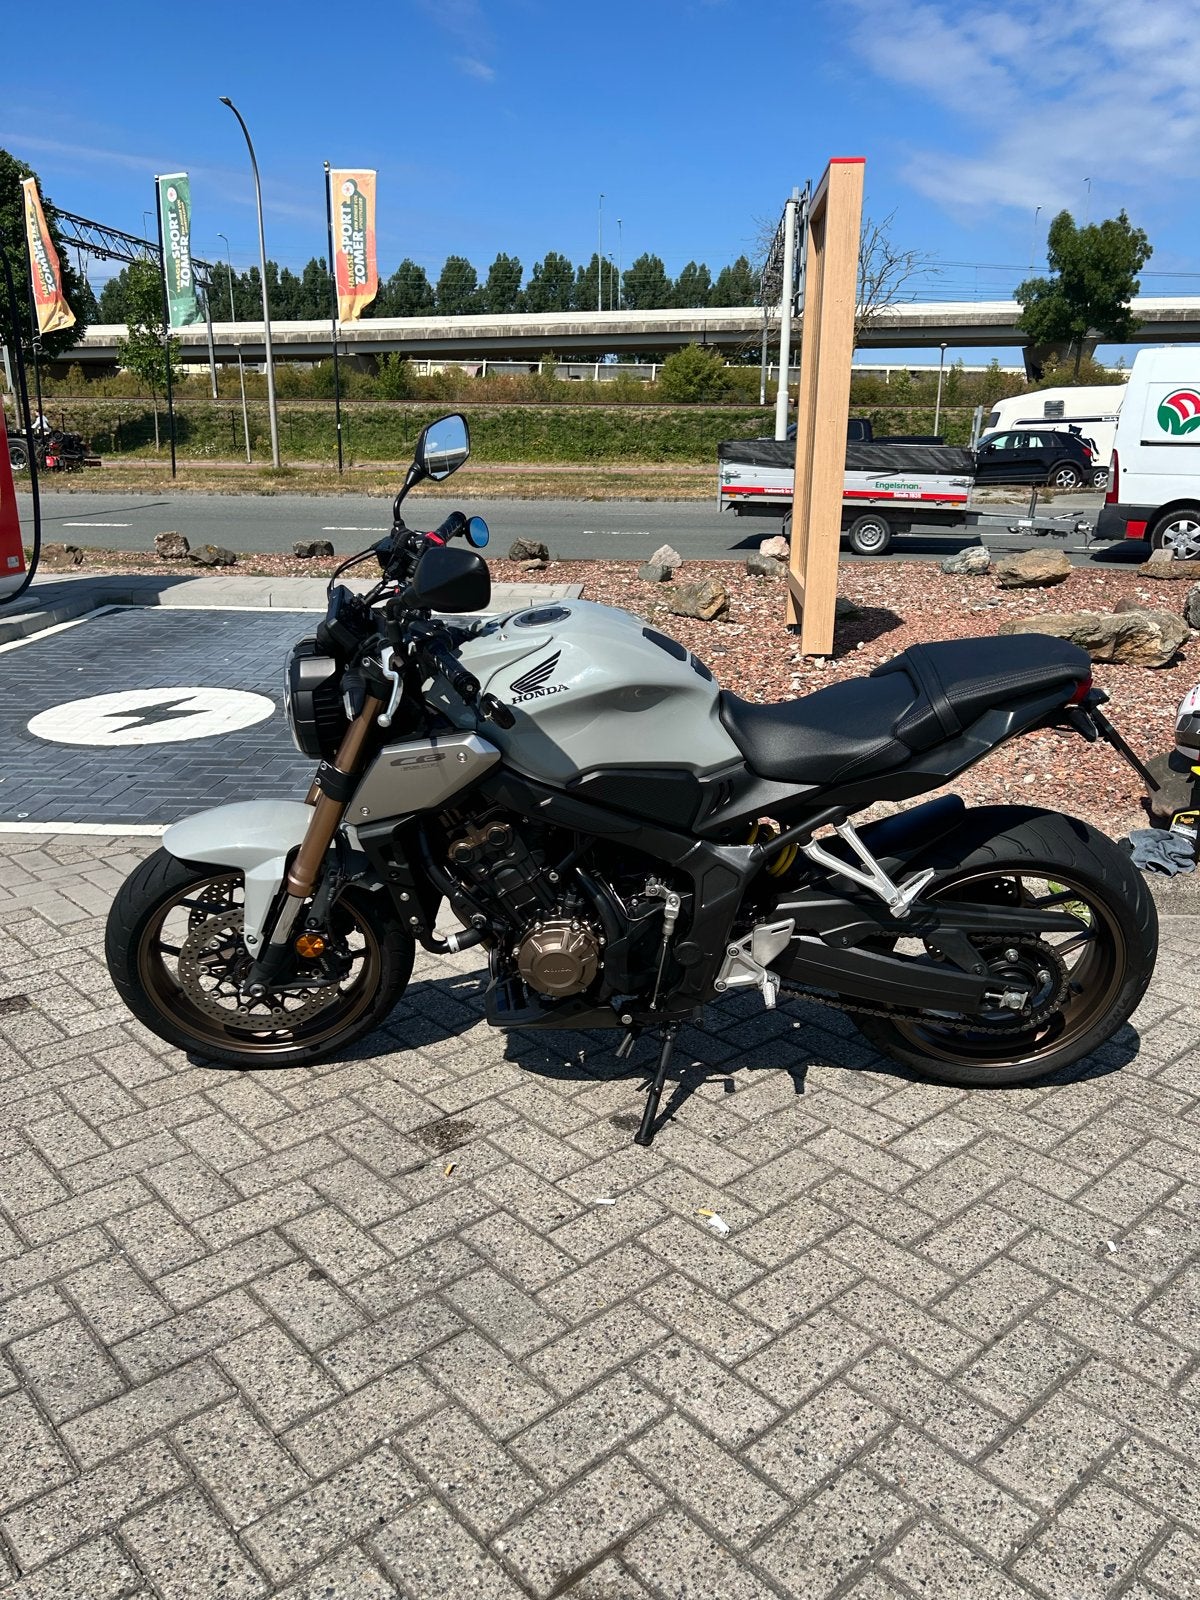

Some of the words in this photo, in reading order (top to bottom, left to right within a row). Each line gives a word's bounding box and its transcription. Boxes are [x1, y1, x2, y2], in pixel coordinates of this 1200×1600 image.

[168, 210, 181, 259] SPORT
[341, 205, 354, 254] SPORT
[38, 240, 57, 293] ZOMER
[180, 235, 191, 288] ZOMER
[353, 231, 366, 285] ZOMER
[875, 481, 922, 491] Engelsman.
[512, 684, 570, 705] HONDA
